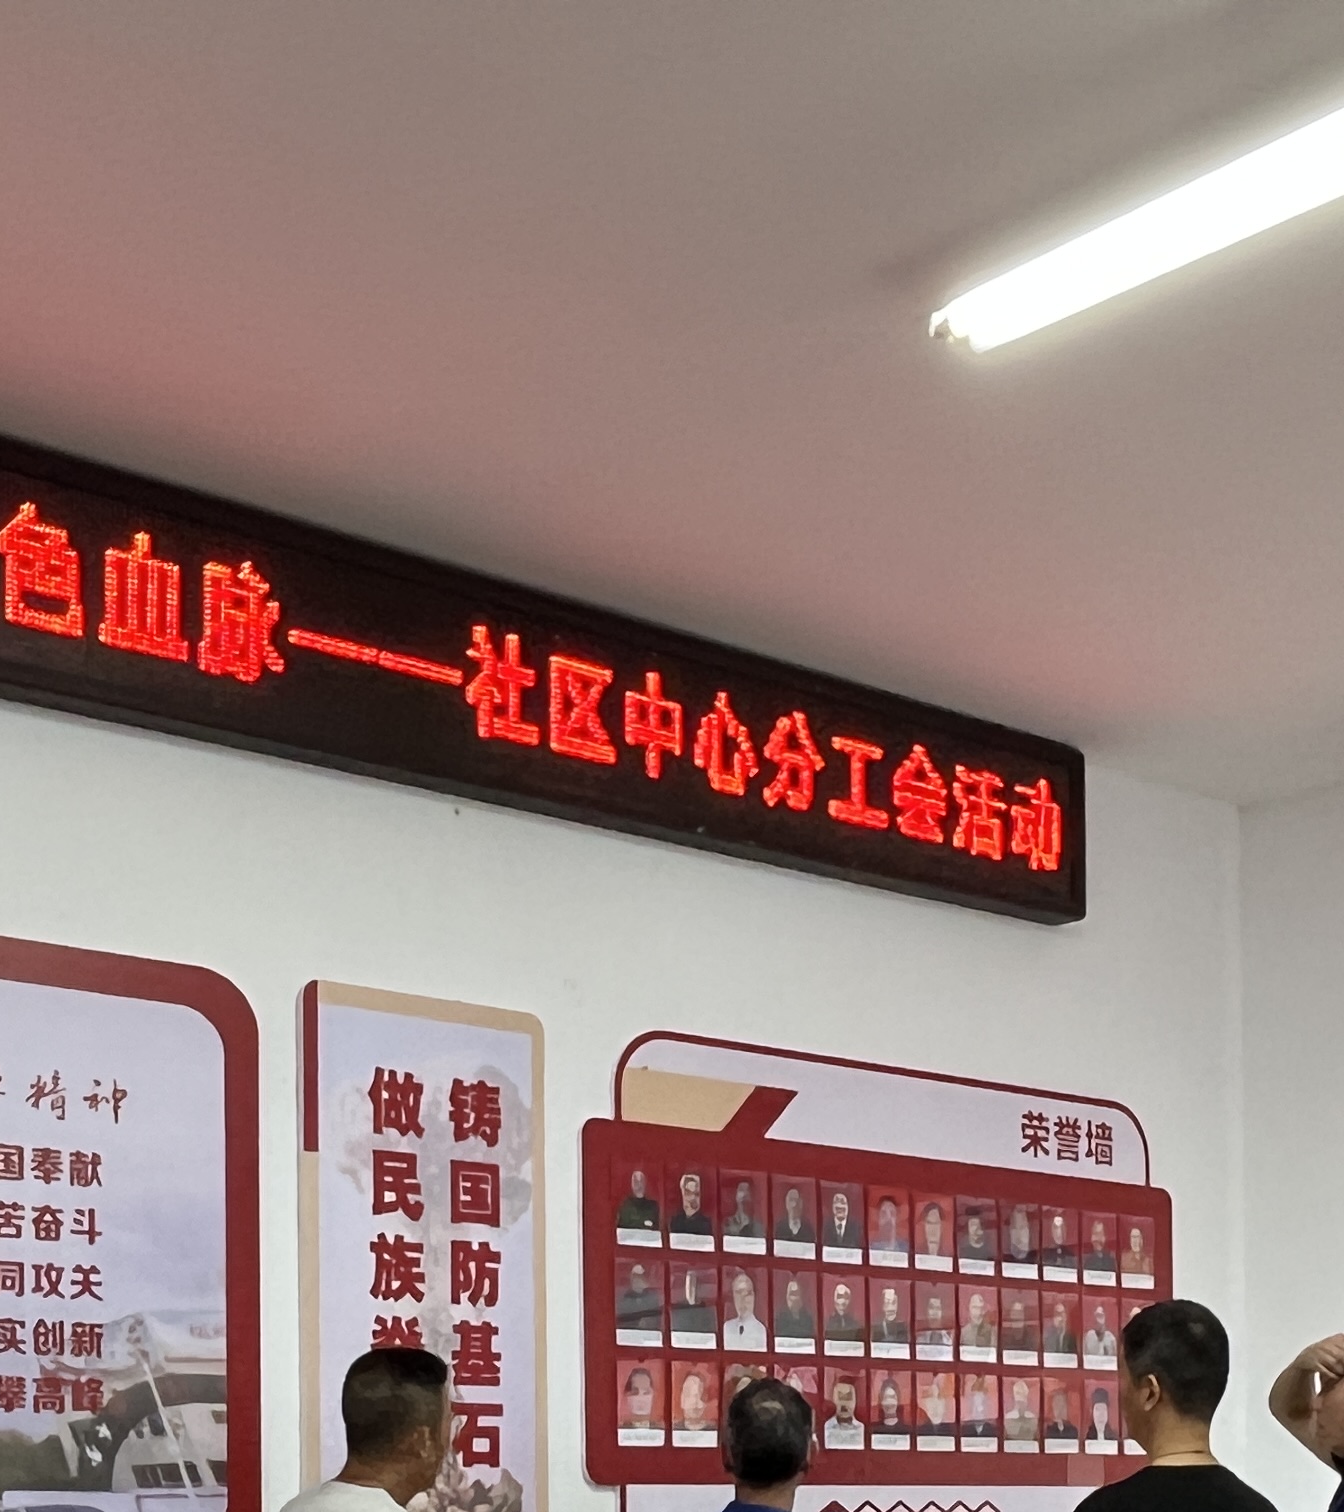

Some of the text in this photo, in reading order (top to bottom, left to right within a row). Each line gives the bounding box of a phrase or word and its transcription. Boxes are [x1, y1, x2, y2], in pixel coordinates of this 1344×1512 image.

[1020, 1109, 1114, 1167] 荣誉墙
[448, 1077, 504, 1469] 铸国防基石
